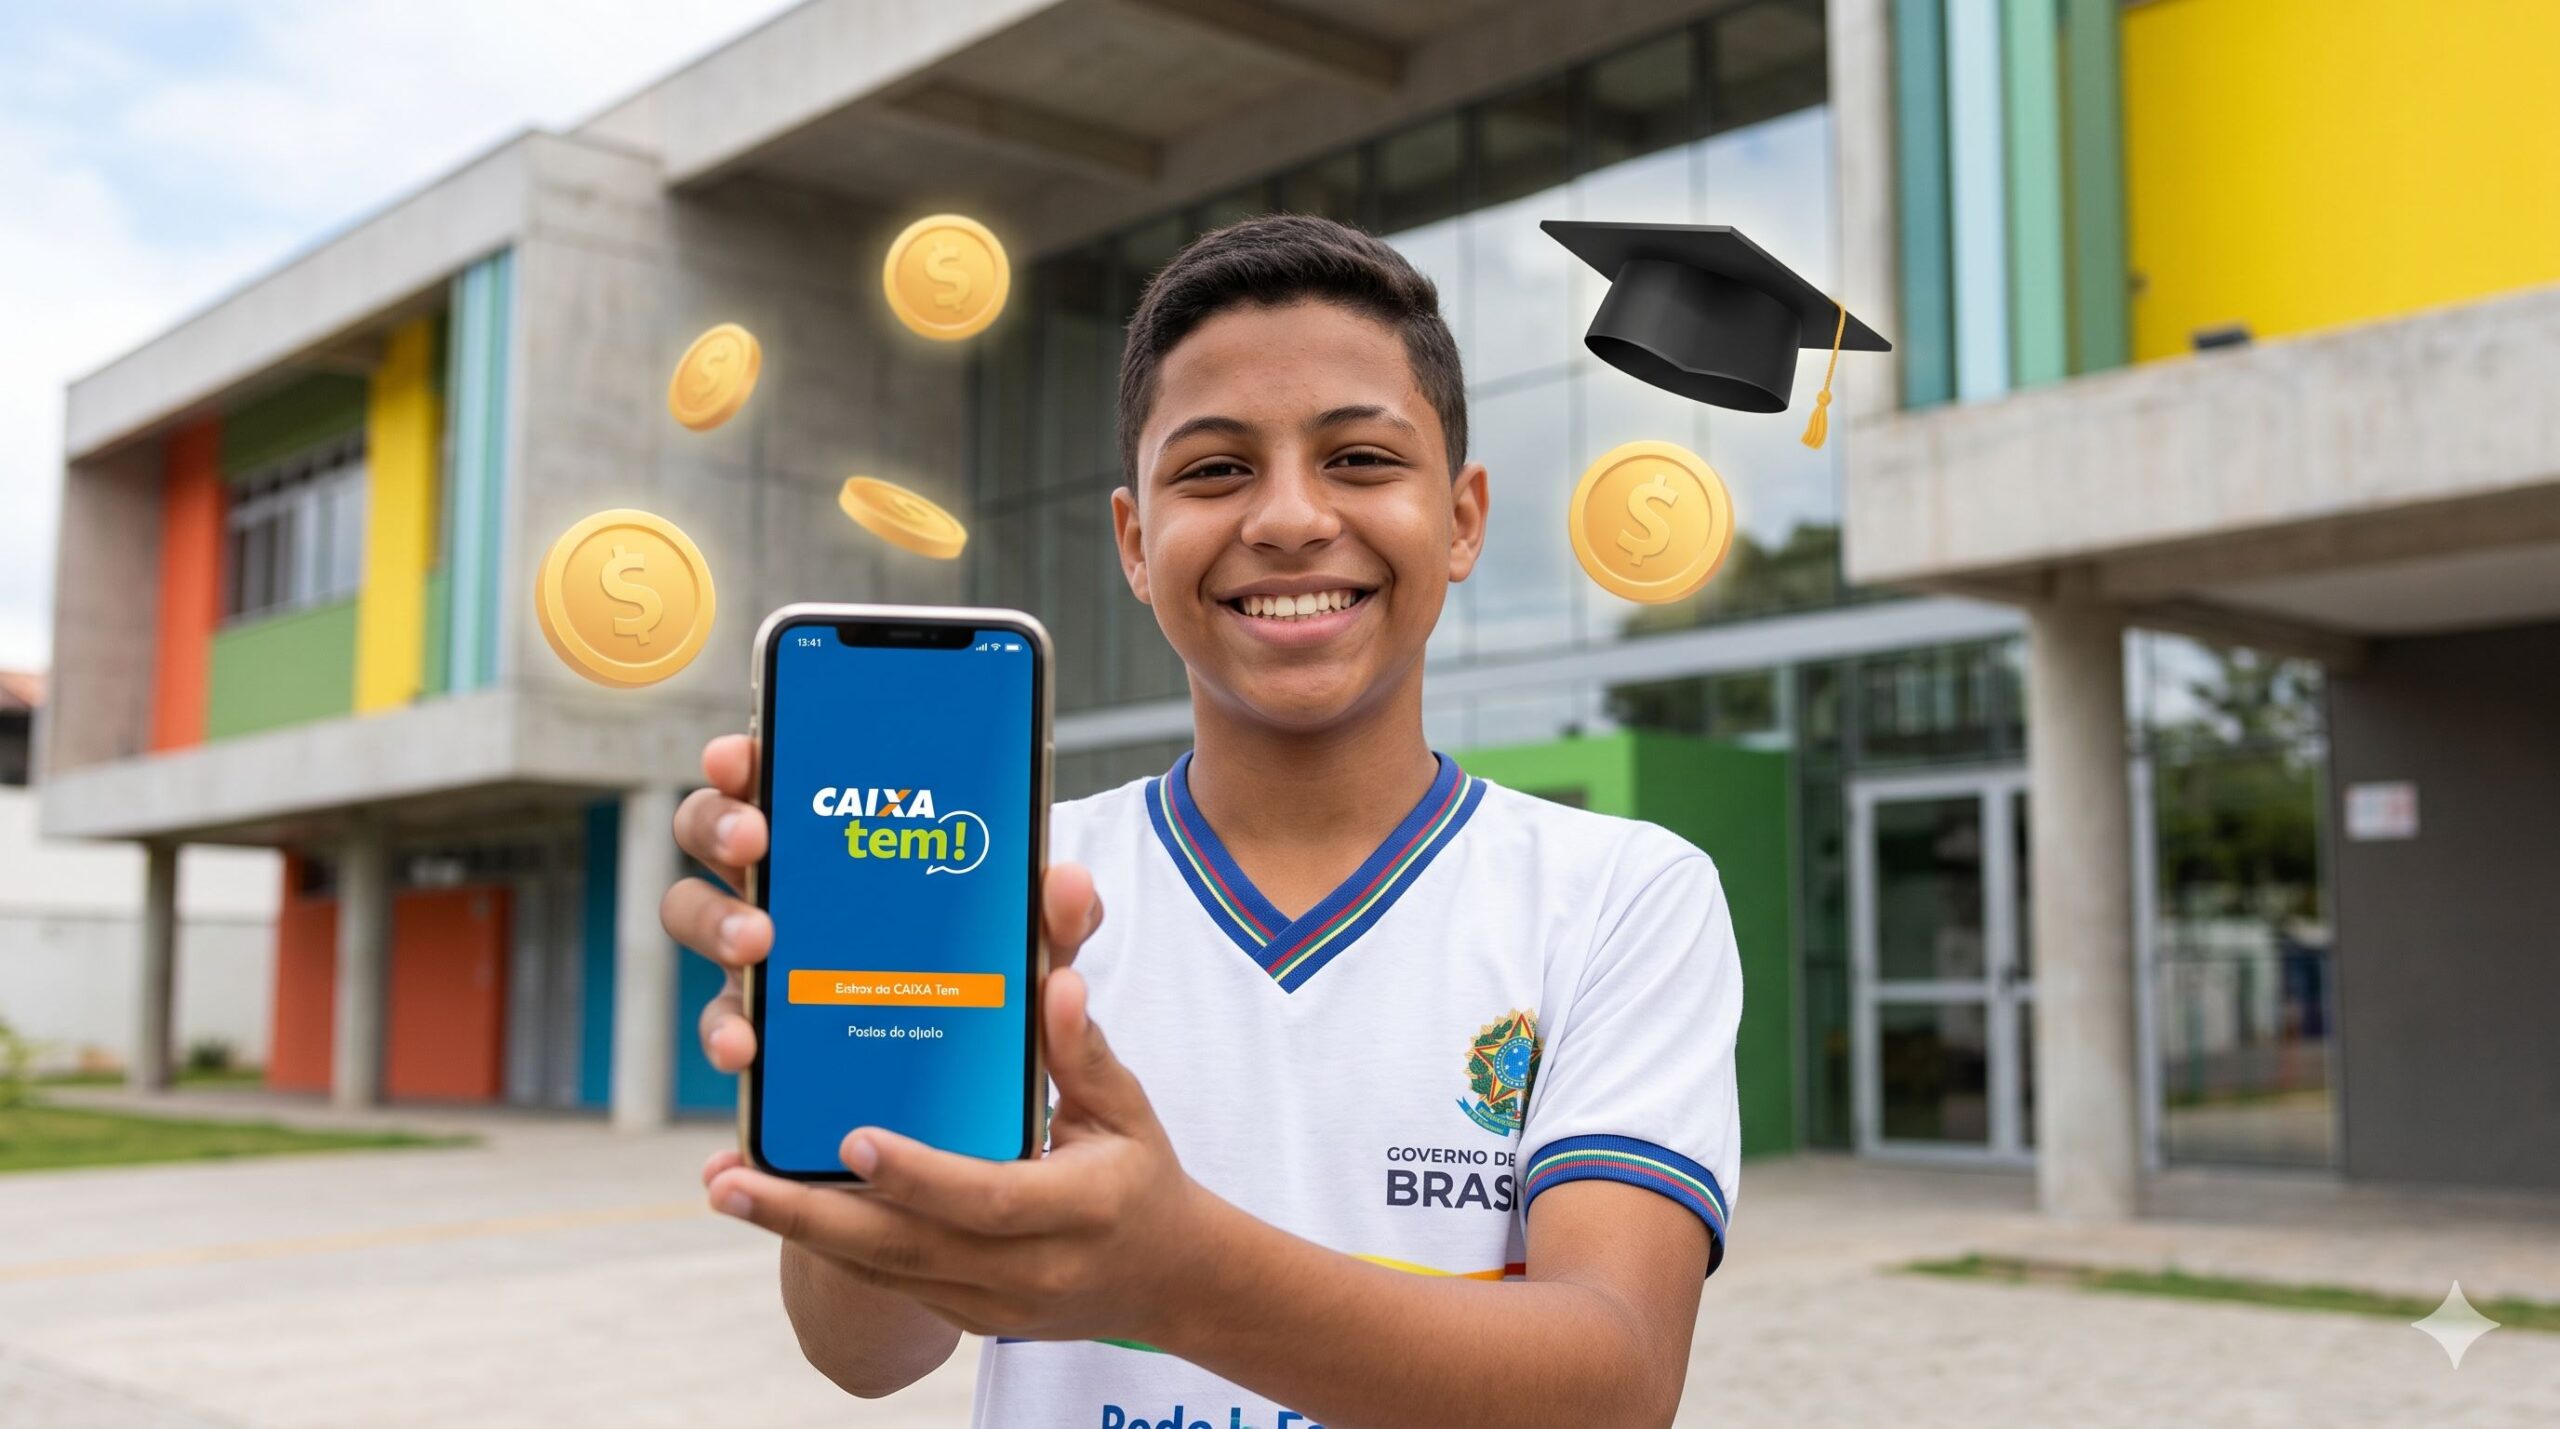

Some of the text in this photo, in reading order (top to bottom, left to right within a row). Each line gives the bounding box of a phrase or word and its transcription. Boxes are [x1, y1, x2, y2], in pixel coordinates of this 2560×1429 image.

[797, 637, 822, 647] 13:41
[812, 787, 936, 818] CAIXA
[844, 819, 967, 861] tem!
[893, 983, 932, 995] CAIXA
[935, 984, 960, 996] Tem
[889, 1025, 905, 1038] do
[1387, 1147, 1488, 1165] GOVERNO
